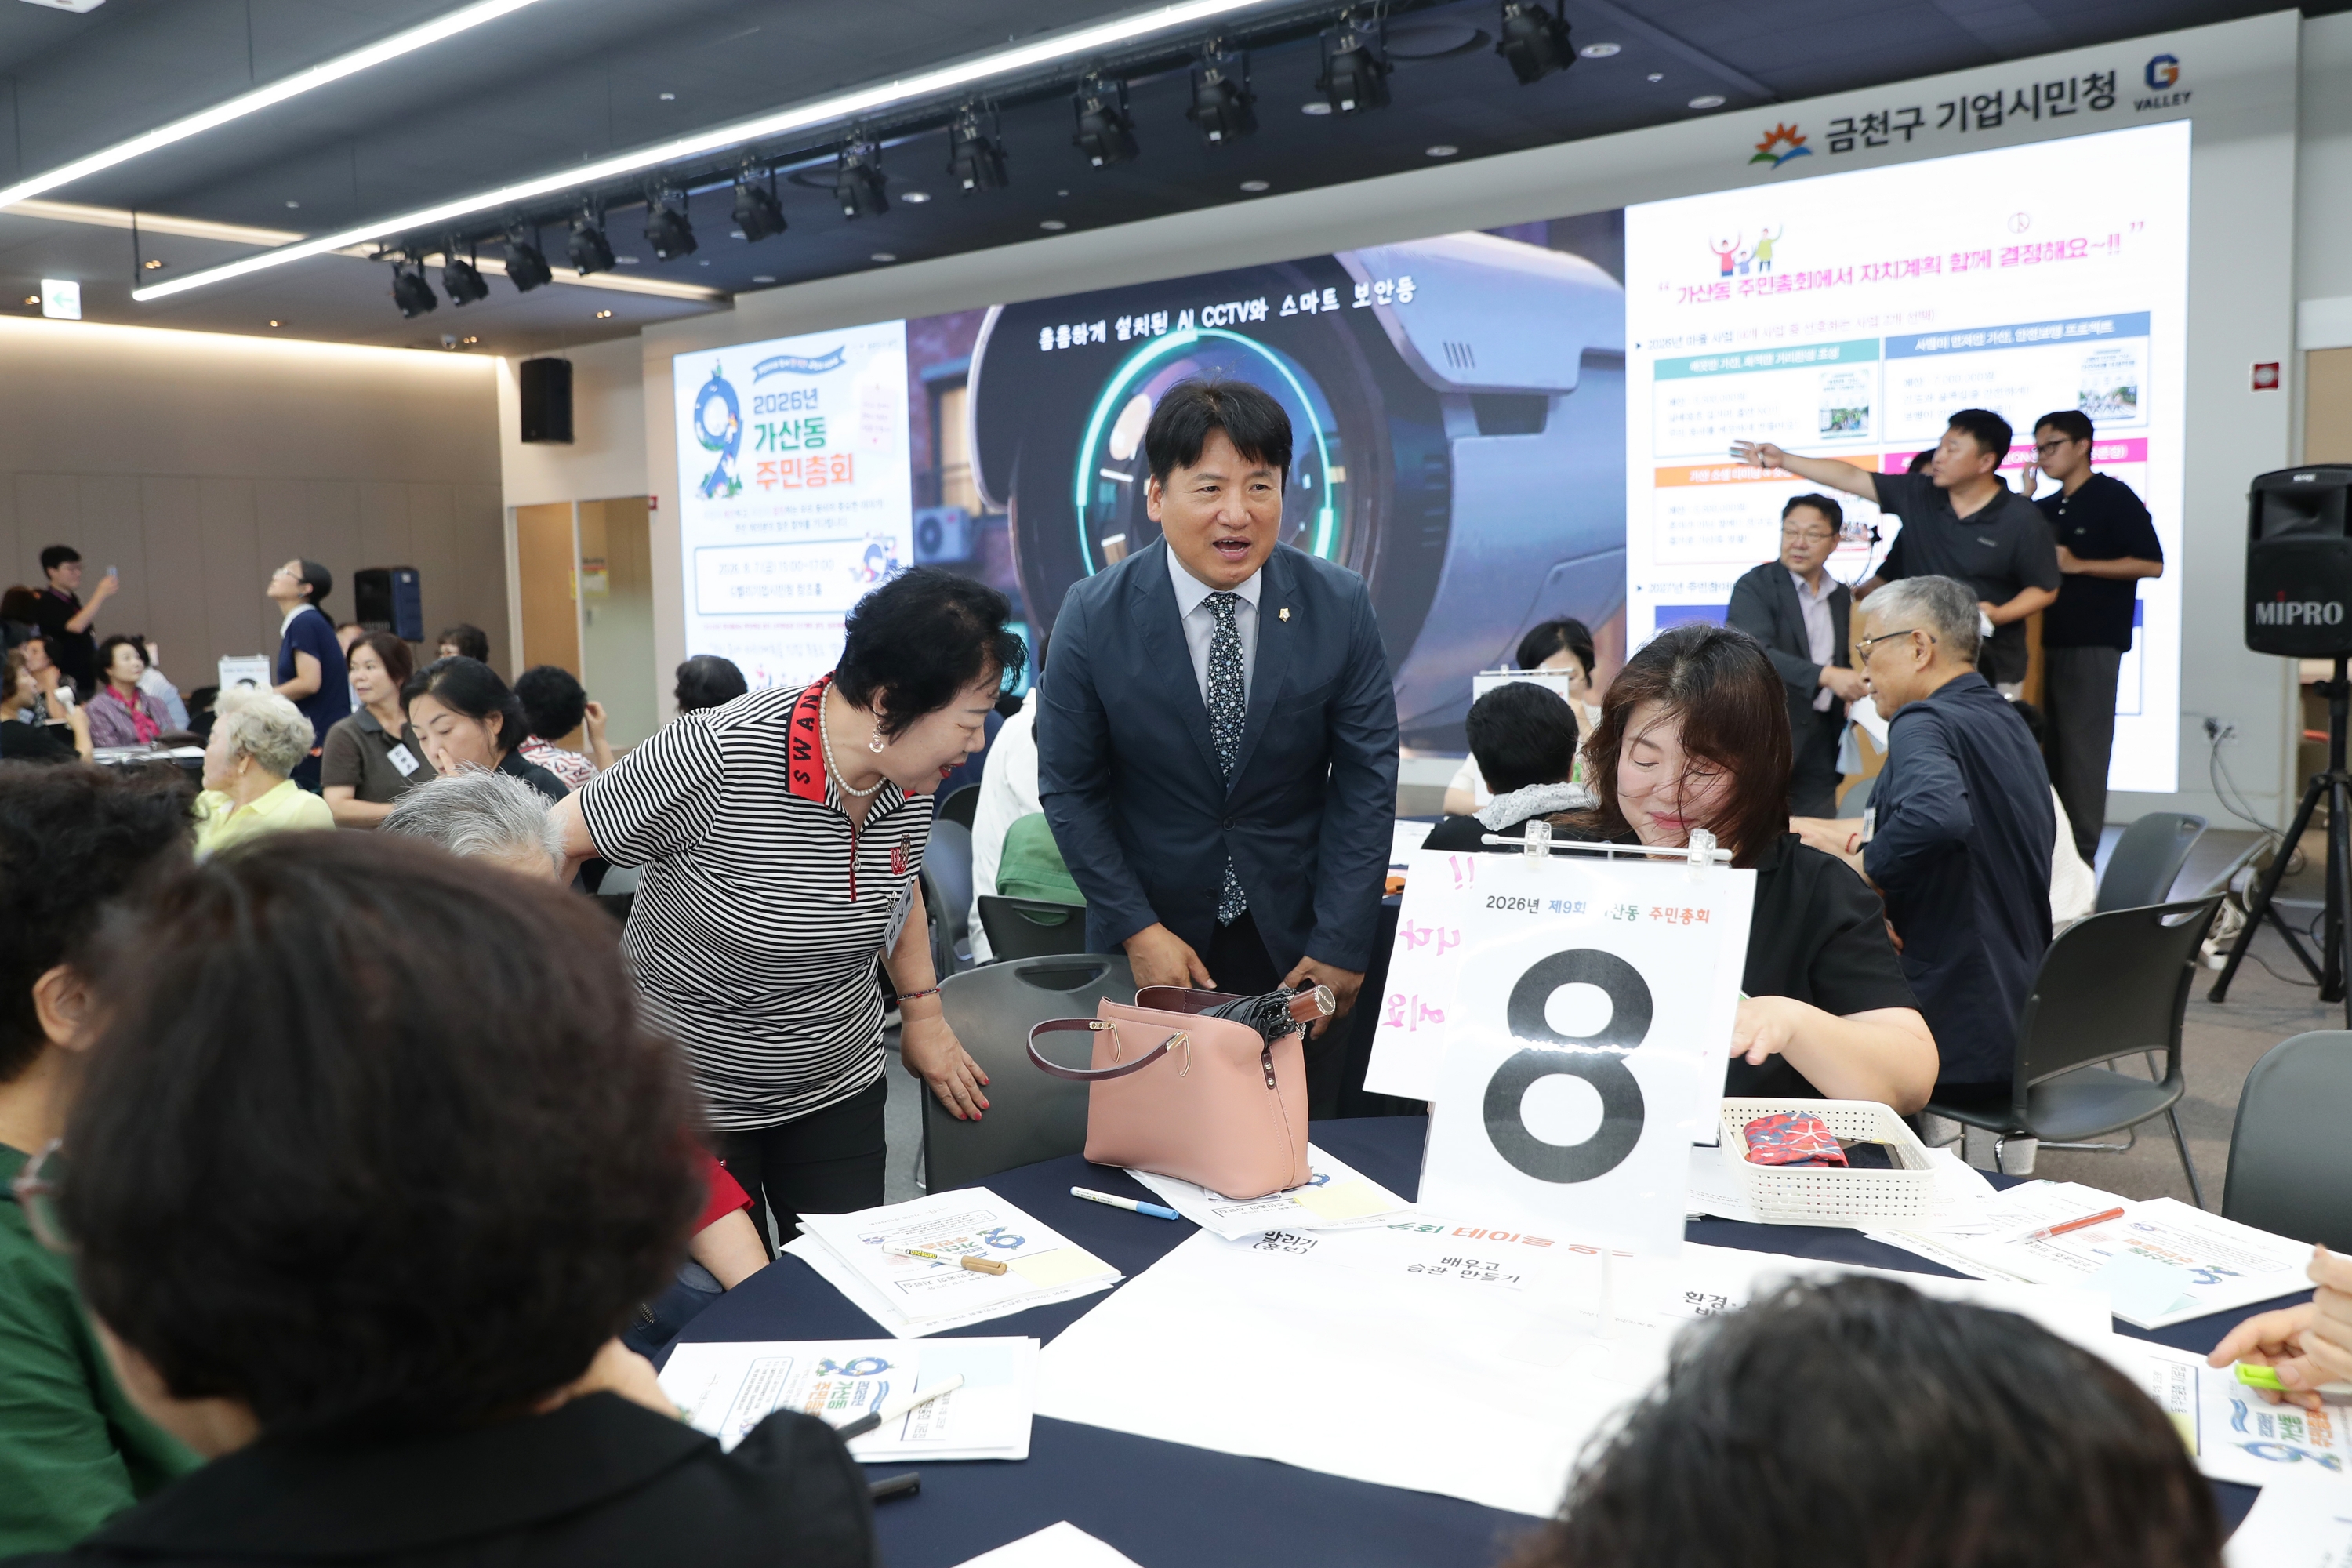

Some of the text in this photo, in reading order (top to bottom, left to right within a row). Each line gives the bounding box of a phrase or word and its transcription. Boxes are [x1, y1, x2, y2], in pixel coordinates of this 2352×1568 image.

[1826, 71, 2117, 154] 금천구 기업시민청
[2134, 90, 2191, 112] VALLEY
[1677, 280, 1730, 305] 가산동
[1737, 268, 1853, 300] 주민총회에서
[1860, 253, 1942, 284] 자치계획
[1950, 249, 1991, 272] 함께
[1038, 275, 1418, 352] 촘촘하게 설치된 AI CCTV와 스마트 보안등
[753, 387, 818, 416] 2026년
[753, 416, 828, 452] 가산동
[756, 452, 855, 492] 주민총회
[1486, 895, 1540, 914] 2026년
[1548, 898, 1587, 915] 제9회
[1648, 906, 1711, 925] 주민총회
[1482, 947, 1654, 1185] 8
[1253, 1239, 1308, 1254] (홍보)
[1263, 1231, 1318, 1250] 알리기
[1453, 1228, 1554, 1248] 테이블
[1407, 1264, 1520, 1283] 습관 만들기
[1441, 1258, 1500, 1272] 배우고
[826, 1381, 854, 1410] 가산동
[850, 1381, 870, 1406] 2026년
[2278, 1414, 2303, 1442] 가산동
